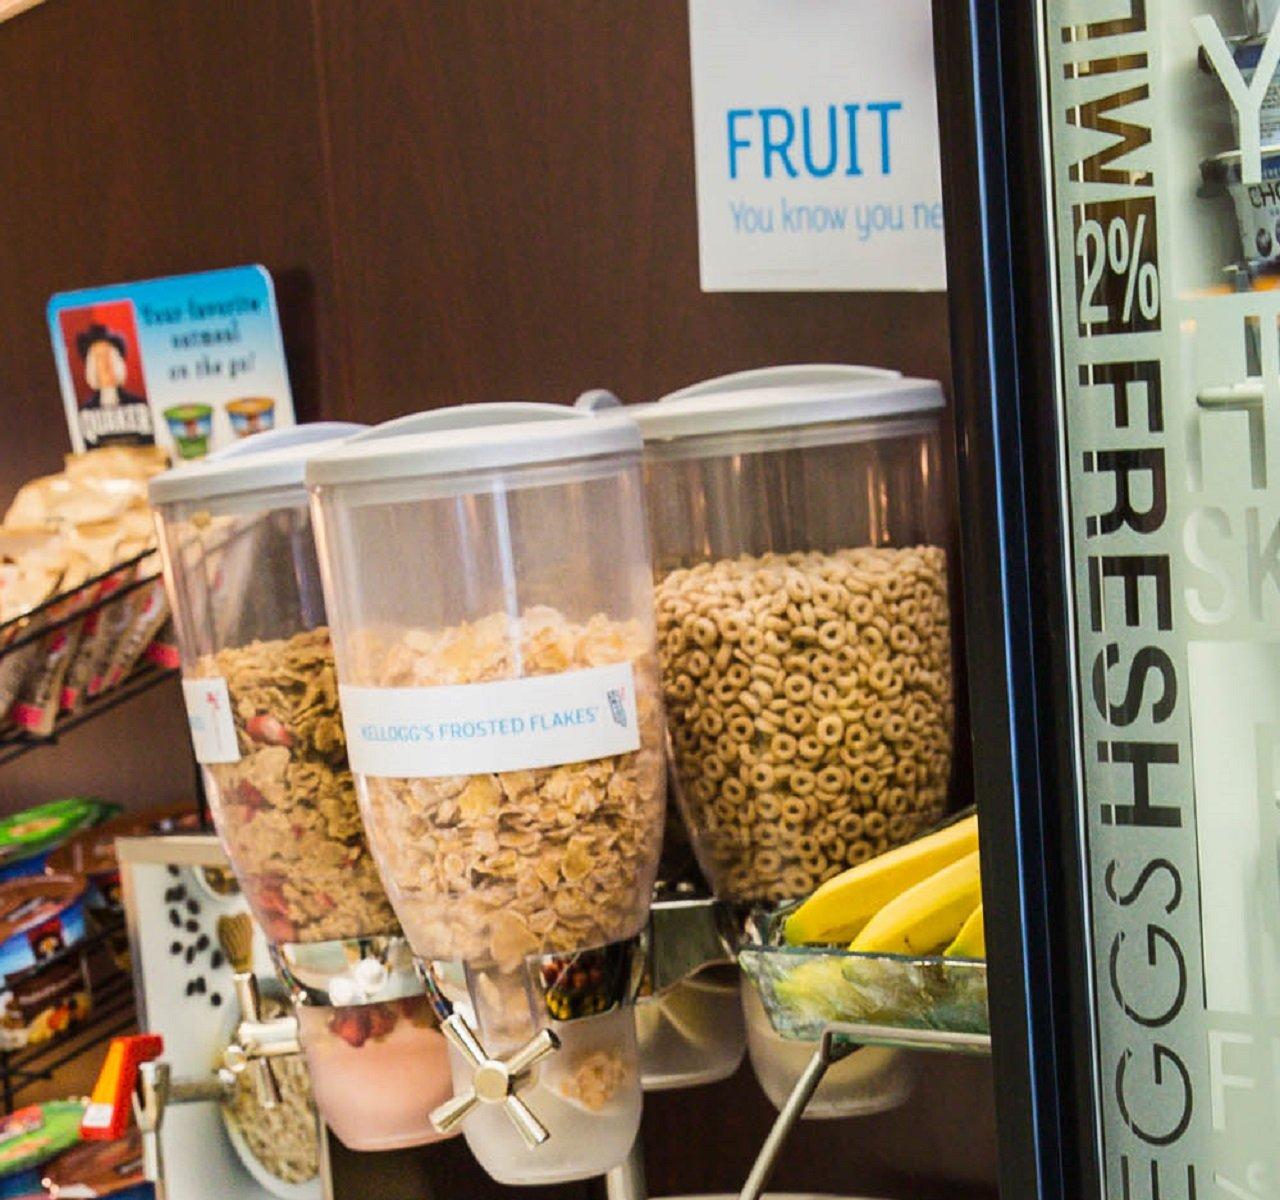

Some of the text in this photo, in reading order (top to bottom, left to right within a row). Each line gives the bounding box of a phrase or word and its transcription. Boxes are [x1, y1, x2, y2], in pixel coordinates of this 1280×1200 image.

[726, 101, 903, 180] FRUIT
[730, 200, 775, 234] You
[781, 196, 848, 234] know
[854, 203, 905, 242] you
[1075, 213, 1159, 324] 2%
[1078, 358, 1183, 829] FRESH
[360, 723, 435, 743] KELLOGG'S
[439, 716, 525, 741] FROSTED
